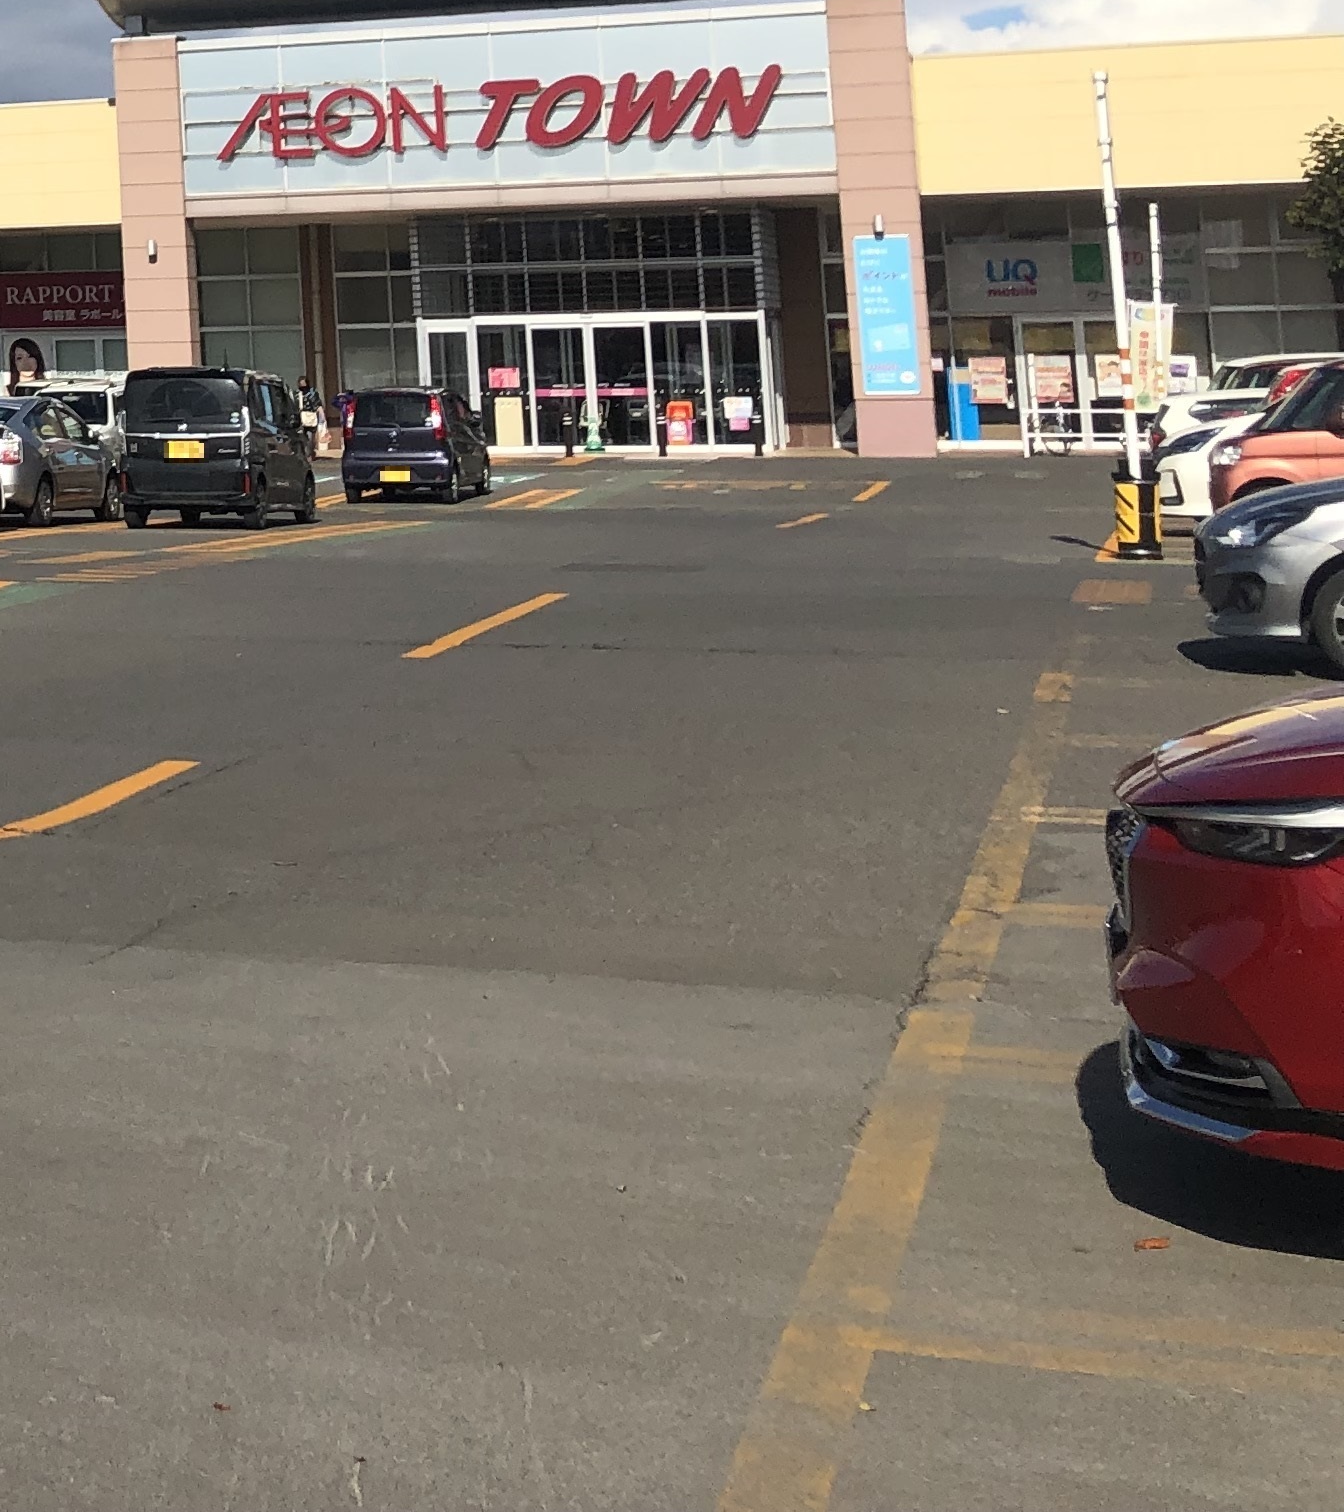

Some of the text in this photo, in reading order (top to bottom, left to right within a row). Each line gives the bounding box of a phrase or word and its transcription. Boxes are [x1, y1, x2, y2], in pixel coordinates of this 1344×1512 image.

[476, 63, 783, 150] TOWN
[985, 258, 1038, 285] UQ
[5, 284, 115, 304] RAPPORT
[988, 285, 1038, 297] mobile
